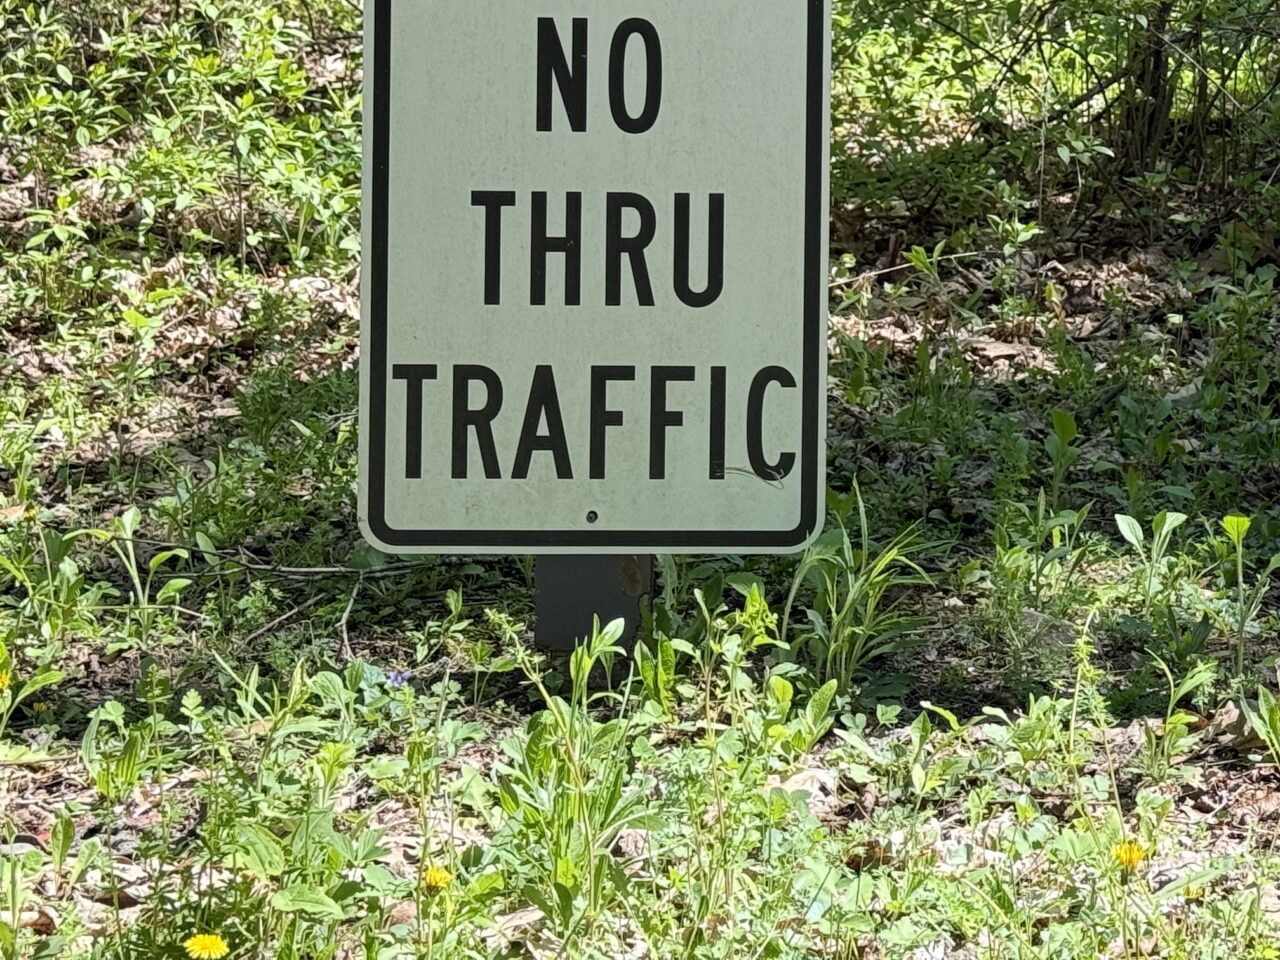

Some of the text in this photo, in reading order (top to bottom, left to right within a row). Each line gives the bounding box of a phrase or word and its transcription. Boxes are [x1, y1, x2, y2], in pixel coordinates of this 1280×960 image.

[535, 16, 663, 135] NO
[470, 190, 726, 308] THRU
[392, 363, 798, 482] TRAFFIC
